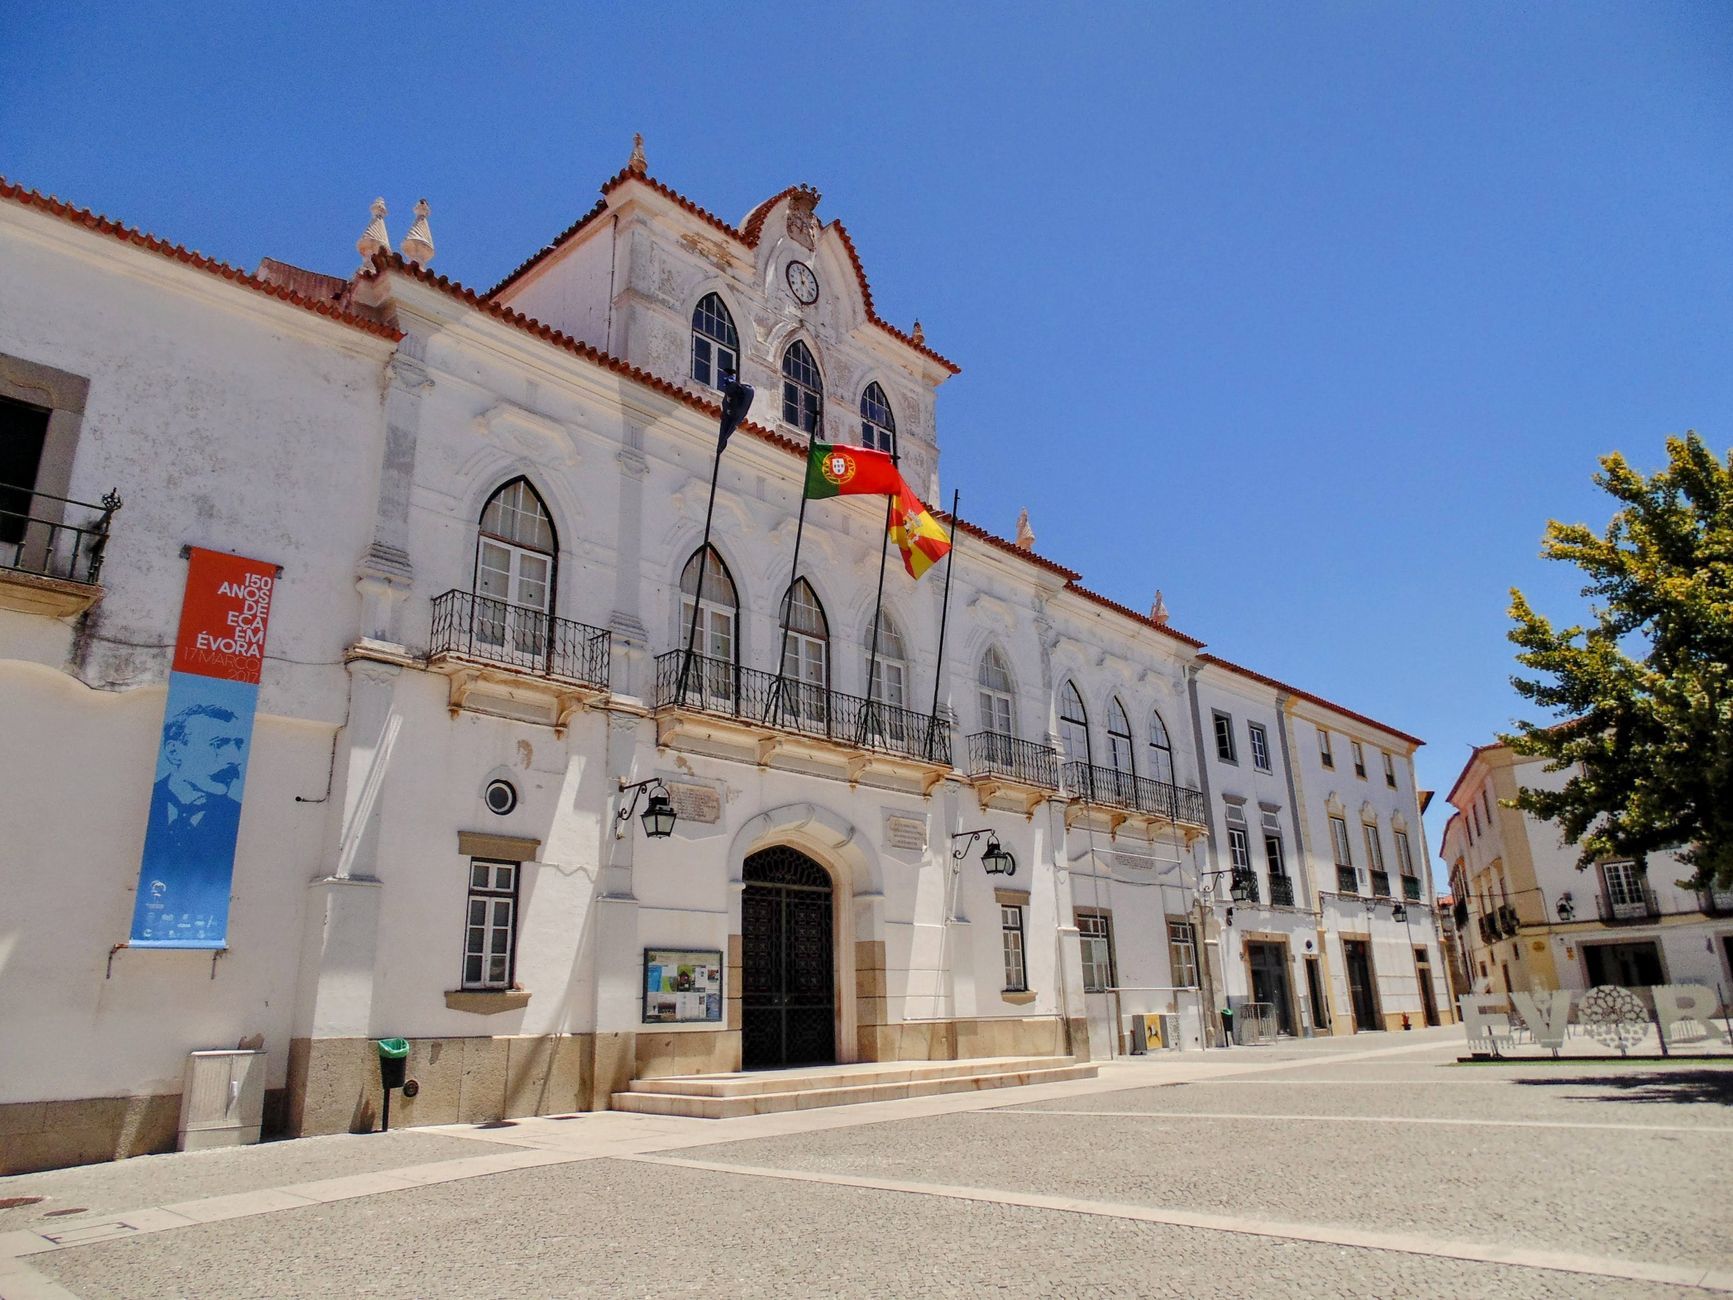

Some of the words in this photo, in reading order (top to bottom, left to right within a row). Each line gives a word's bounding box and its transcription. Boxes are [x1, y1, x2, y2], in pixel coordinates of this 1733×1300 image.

[245, 573, 271, 590] 150
[218, 582, 269, 603] ANOS
[244, 600, 268, 617] DE
[228, 611, 264, 630] EÇA
[197, 631, 259, 657] ÉVORA
[235, 627, 263, 644] EM
[1458, 975, 1733, 1050] ÉVOR
